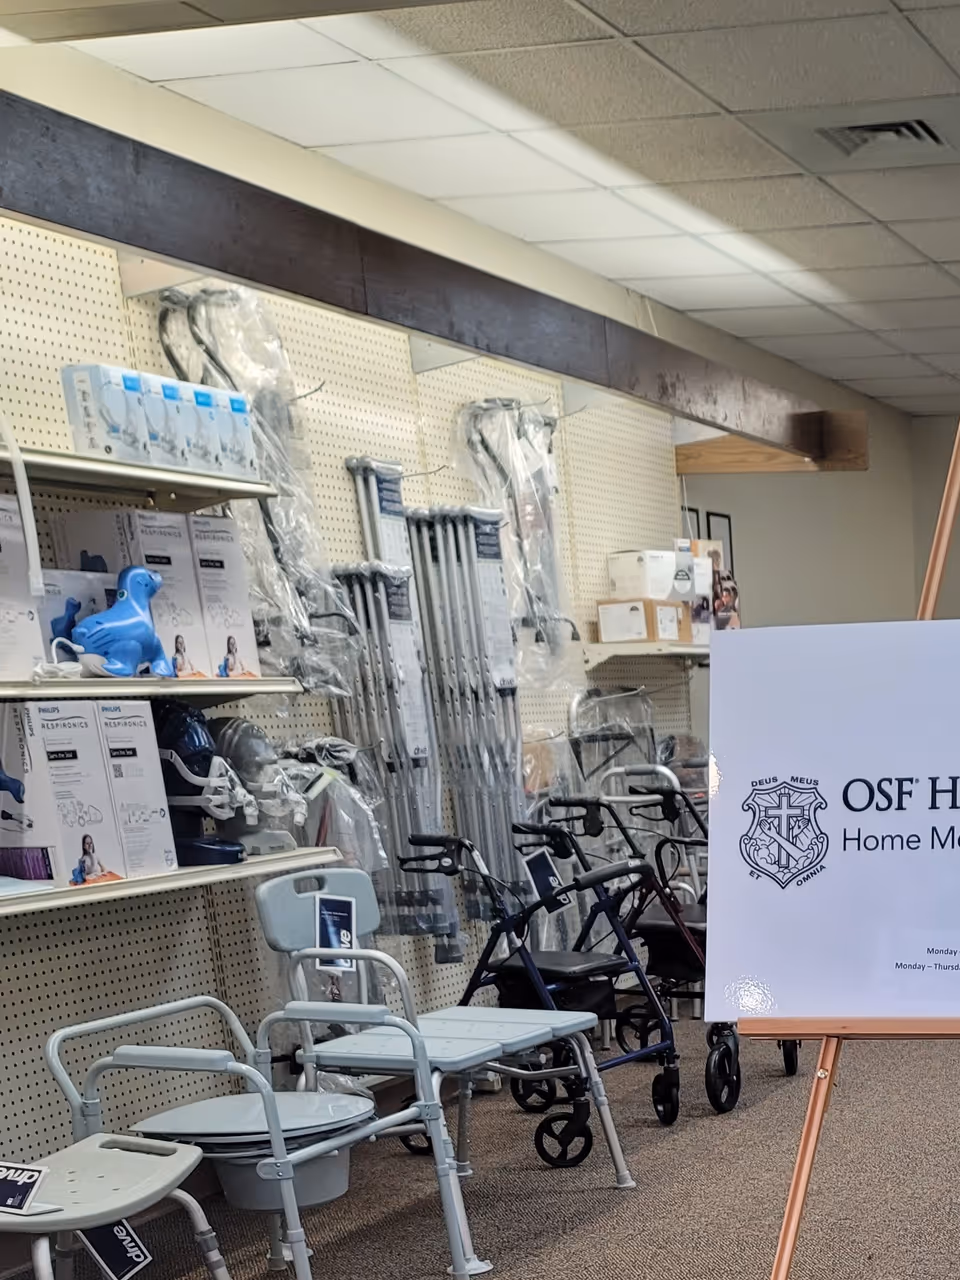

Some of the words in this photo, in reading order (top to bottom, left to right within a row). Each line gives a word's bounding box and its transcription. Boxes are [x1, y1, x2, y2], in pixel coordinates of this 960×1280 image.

[38, 706, 60, 714] PHILIPS
[24, 707, 35, 737] PHILIPS
[41, 721, 89, 729] RESPIRONICS
[104, 720, 148, 728] RESPIRONICS
[12, 707, 29, 774] RESPIRONICS
[751, 776, 778, 787] DEUS
[790, 776, 819, 786] MEUS
[843, 827, 921, 851] Home
[749, 869, 762, 881] ET
[796, 864, 827, 887] OMNIA
[926, 947, 958, 956] Monday
[895, 962, 926, 971] Monday
[113, 1225, 145, 1262] drive
